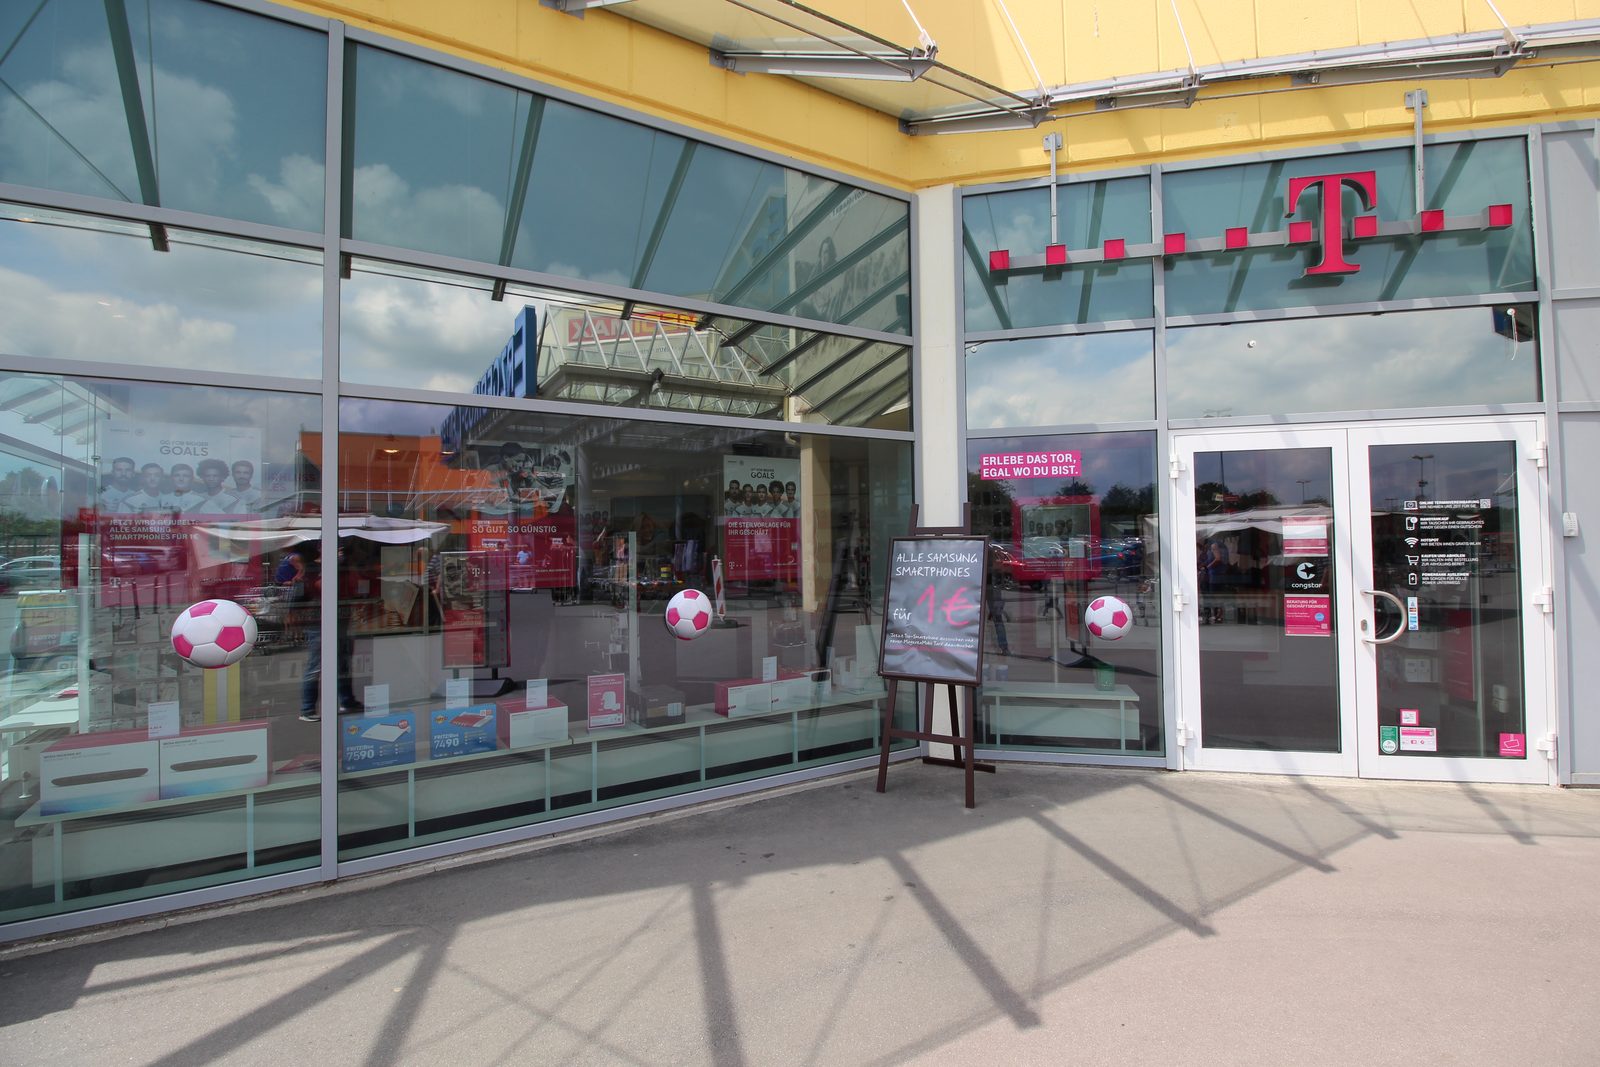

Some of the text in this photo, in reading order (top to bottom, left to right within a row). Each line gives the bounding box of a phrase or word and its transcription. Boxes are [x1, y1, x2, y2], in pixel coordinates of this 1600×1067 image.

[1284, 170, 1377, 276] T
[160, 446, 208, 456] GOALS
[982, 453, 1076, 466] ERLEBE DAS TOR,
[983, 465, 1078, 477] EGAL WO DU BIST.
[486, 526, 506, 534] GUT,
[521, 524, 557, 533] GÜNSTIG
[896, 552, 978, 563] ALLE SAMSUNG
[896, 566, 970, 577] SMARTPHONES
[893, 608, 912, 620] für
[434, 738, 459, 749] 7490
[346, 749, 374, 761] 7590
